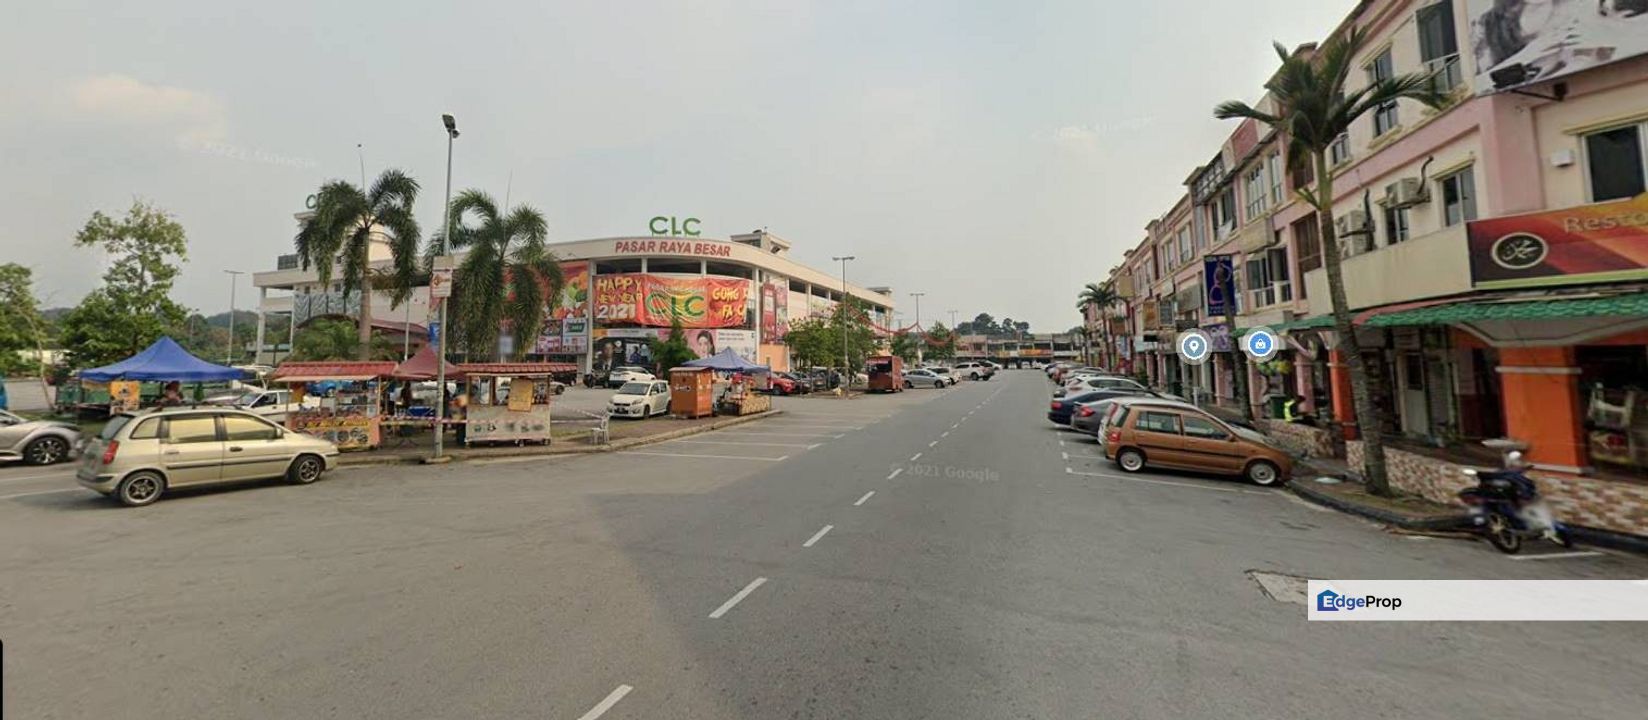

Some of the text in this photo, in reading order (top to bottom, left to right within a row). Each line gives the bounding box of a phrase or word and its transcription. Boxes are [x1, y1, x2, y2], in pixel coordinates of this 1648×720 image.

[649, 216, 701, 236] CLC
[615, 241, 731, 257] PASAR RAYA BESAR
[597, 277, 642, 292] HAPPY
[597, 303, 635, 320] 2021
[645, 291, 704, 317] CLC
